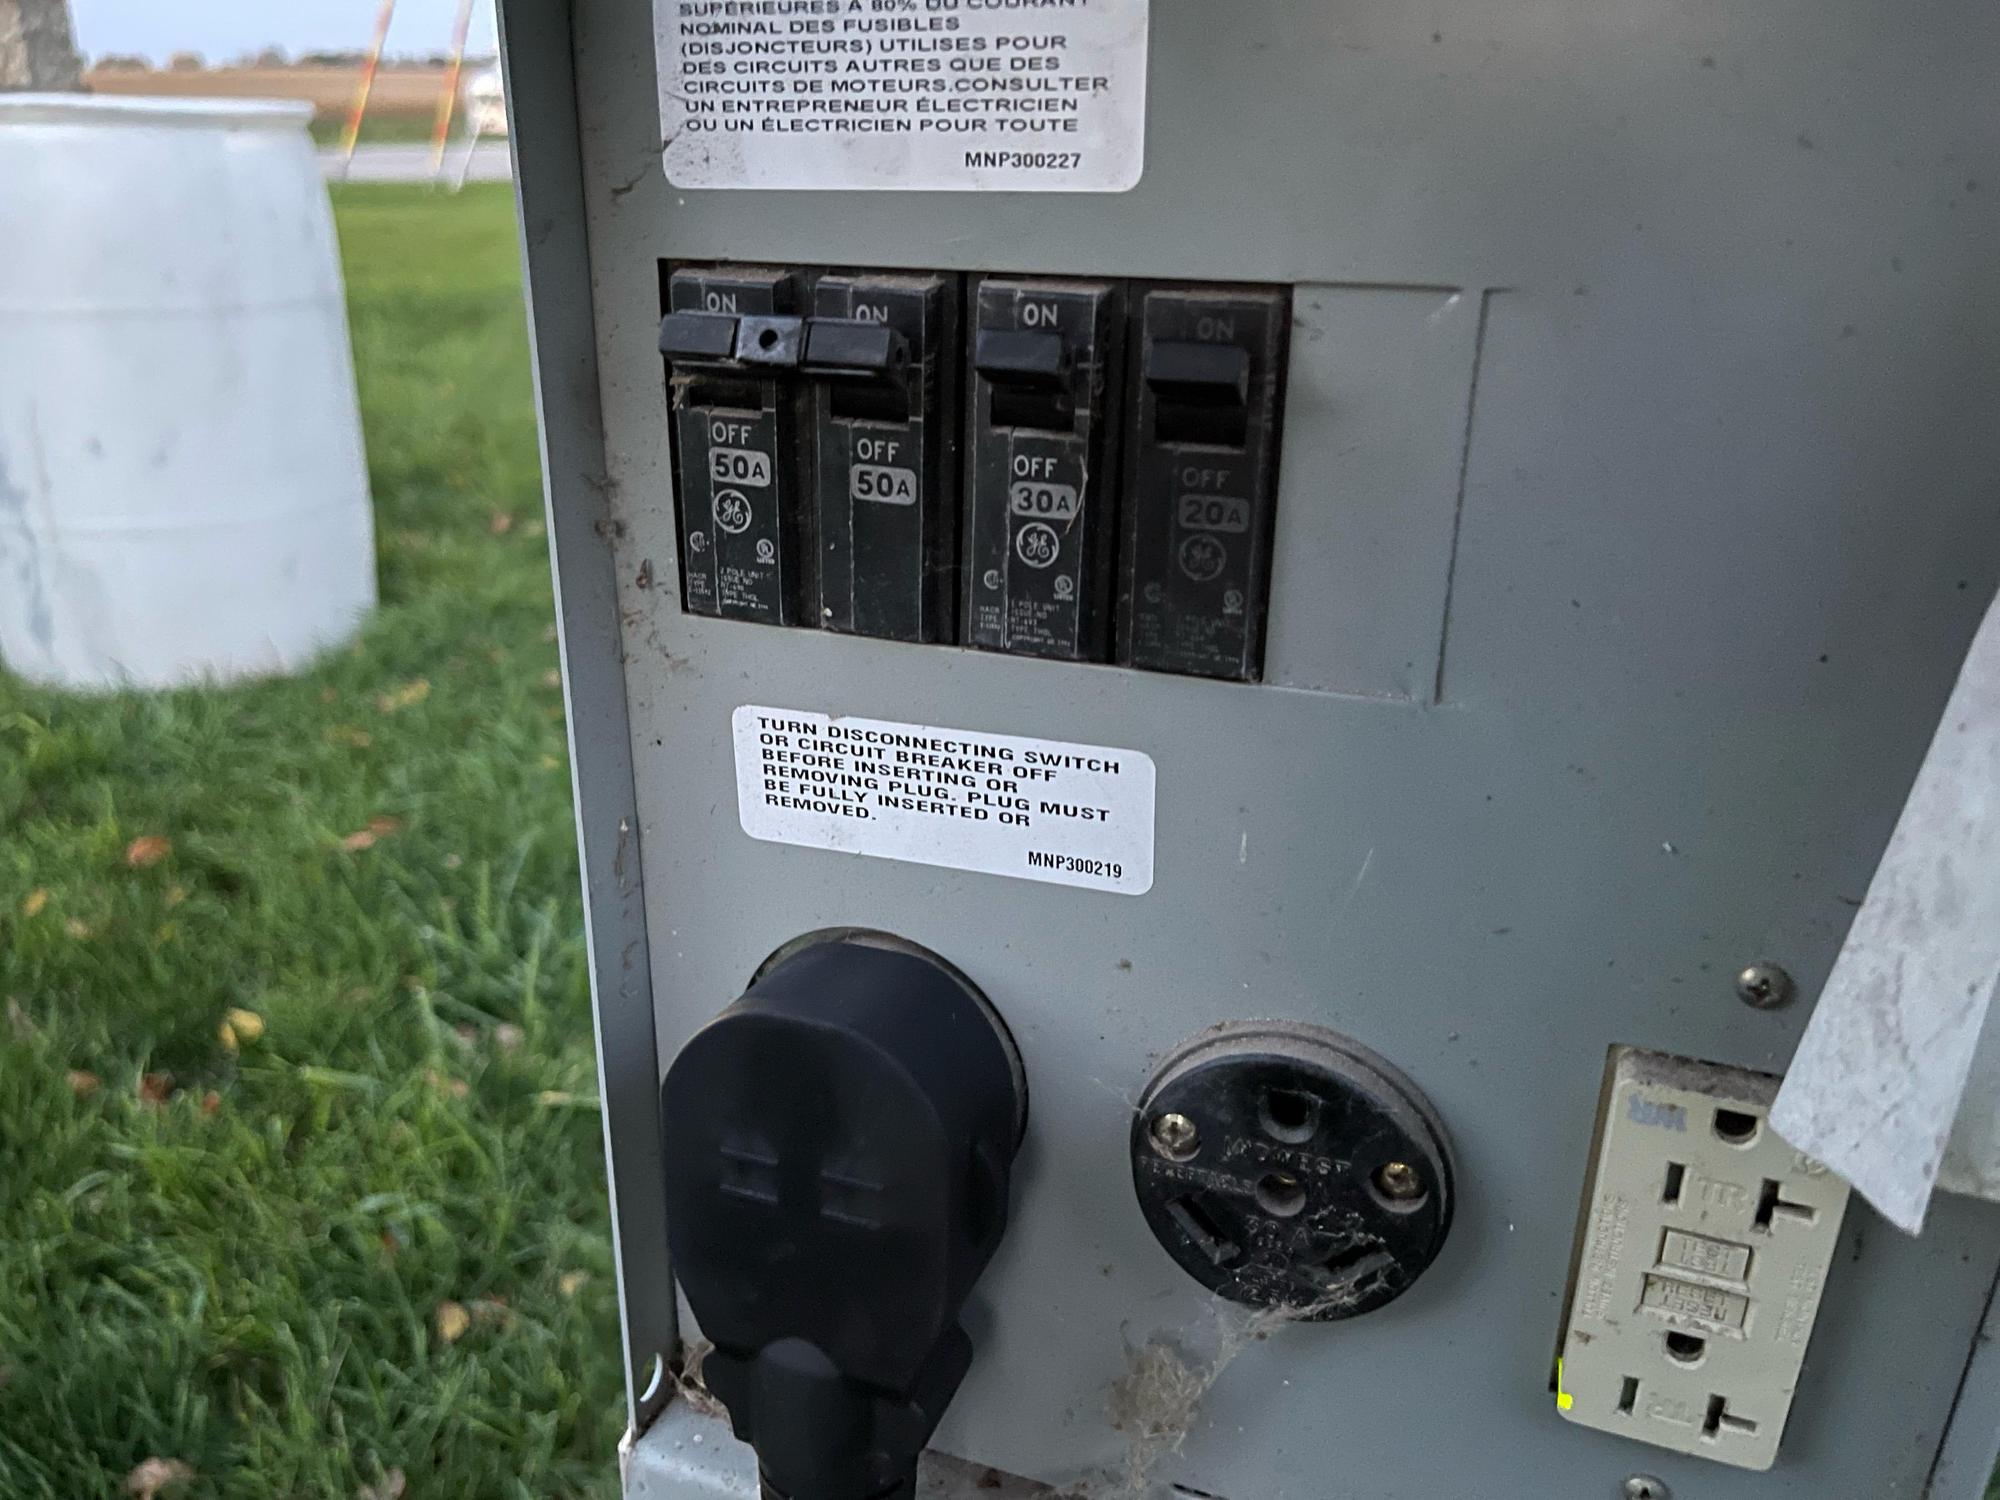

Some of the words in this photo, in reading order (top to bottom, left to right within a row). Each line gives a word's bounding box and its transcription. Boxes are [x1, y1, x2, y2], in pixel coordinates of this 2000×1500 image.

[872, 0, 917, 12] 80%
[926, 0, 958, 11] DU
[681, 21, 782, 36] NOMINAL
[789, 20, 835, 34] DES
[844, 16, 960, 33] FUSIBLES
[681, 39, 872, 57] (DISJONCTEURS)
[880, 36, 987, 53] UTILISES
[996, 36, 1067, 50] POUR
[683, 61, 726, 75] DES
[734, 60, 838, 74] CIRCUITS
[846, 58, 941, 73] AUTRES
[950, 57, 1002, 72] QUE
[1010, 56, 1060, 71] DES
[684, 80, 785, 94] CIRCUITS
[794, 80, 823, 93] DE
[685, 99, 714, 113] UN
[722, 99, 908, 113] ENTREPRENEUR
[916, 96, 1078, 112] ÉLECTRICIEN
[686, 119, 717, 132] OU
[725, 119, 754, 131] UN
[762, 117, 911, 132] ÉLECTRICIEN
[920, 118, 987, 132] POUR
[994, 118, 1078, 132] TOUTE
[965, 152, 1082, 169] MNP300227
[706, 292, 736, 314] ON
[856, 304, 888, 322] ON
[1023, 303, 1058, 327] ON
[1196, 317, 1234, 340] ON
[711, 421, 752, 445] OFF
[857, 438, 900, 463] OFF
[715, 453, 765, 480] 50A
[1013, 454, 1058, 479] OFF
[1181, 466, 1231, 490] OFF
[857, 471, 911, 498] 50A
[1017, 487, 1071, 514] 30A
[1184, 501, 1242, 526] 20A
[757, 717, 817, 735] TURN
[828, 727, 1014, 761] DISCONNECTING
[1025, 751, 1120, 774] SWITCH
[760, 734, 788, 747] OR
[798, 738, 886, 760] CIRCUIT
[896, 751, 1003, 775] BREAKER
[1013, 766, 1057, 781] OFF
[762, 749, 845, 770] BEFORE
[855, 761, 976, 788] INSERTING
[986, 779, 1018, 793] OR
[763, 764, 878, 790] REMOVING
[888, 781, 957, 801] PLUG.
[968, 792, 1030, 811] PLUG
[1040, 802, 1110, 821] MUST
[765, 779, 790, 792] BE
[800, 784, 868, 803] FULLY
[878, 795, 988, 820] INSERTED
[998, 812, 1030, 827] OR
[765, 794, 877, 820] REMOVED.
[1028, 851, 1122, 878] MNP300219
